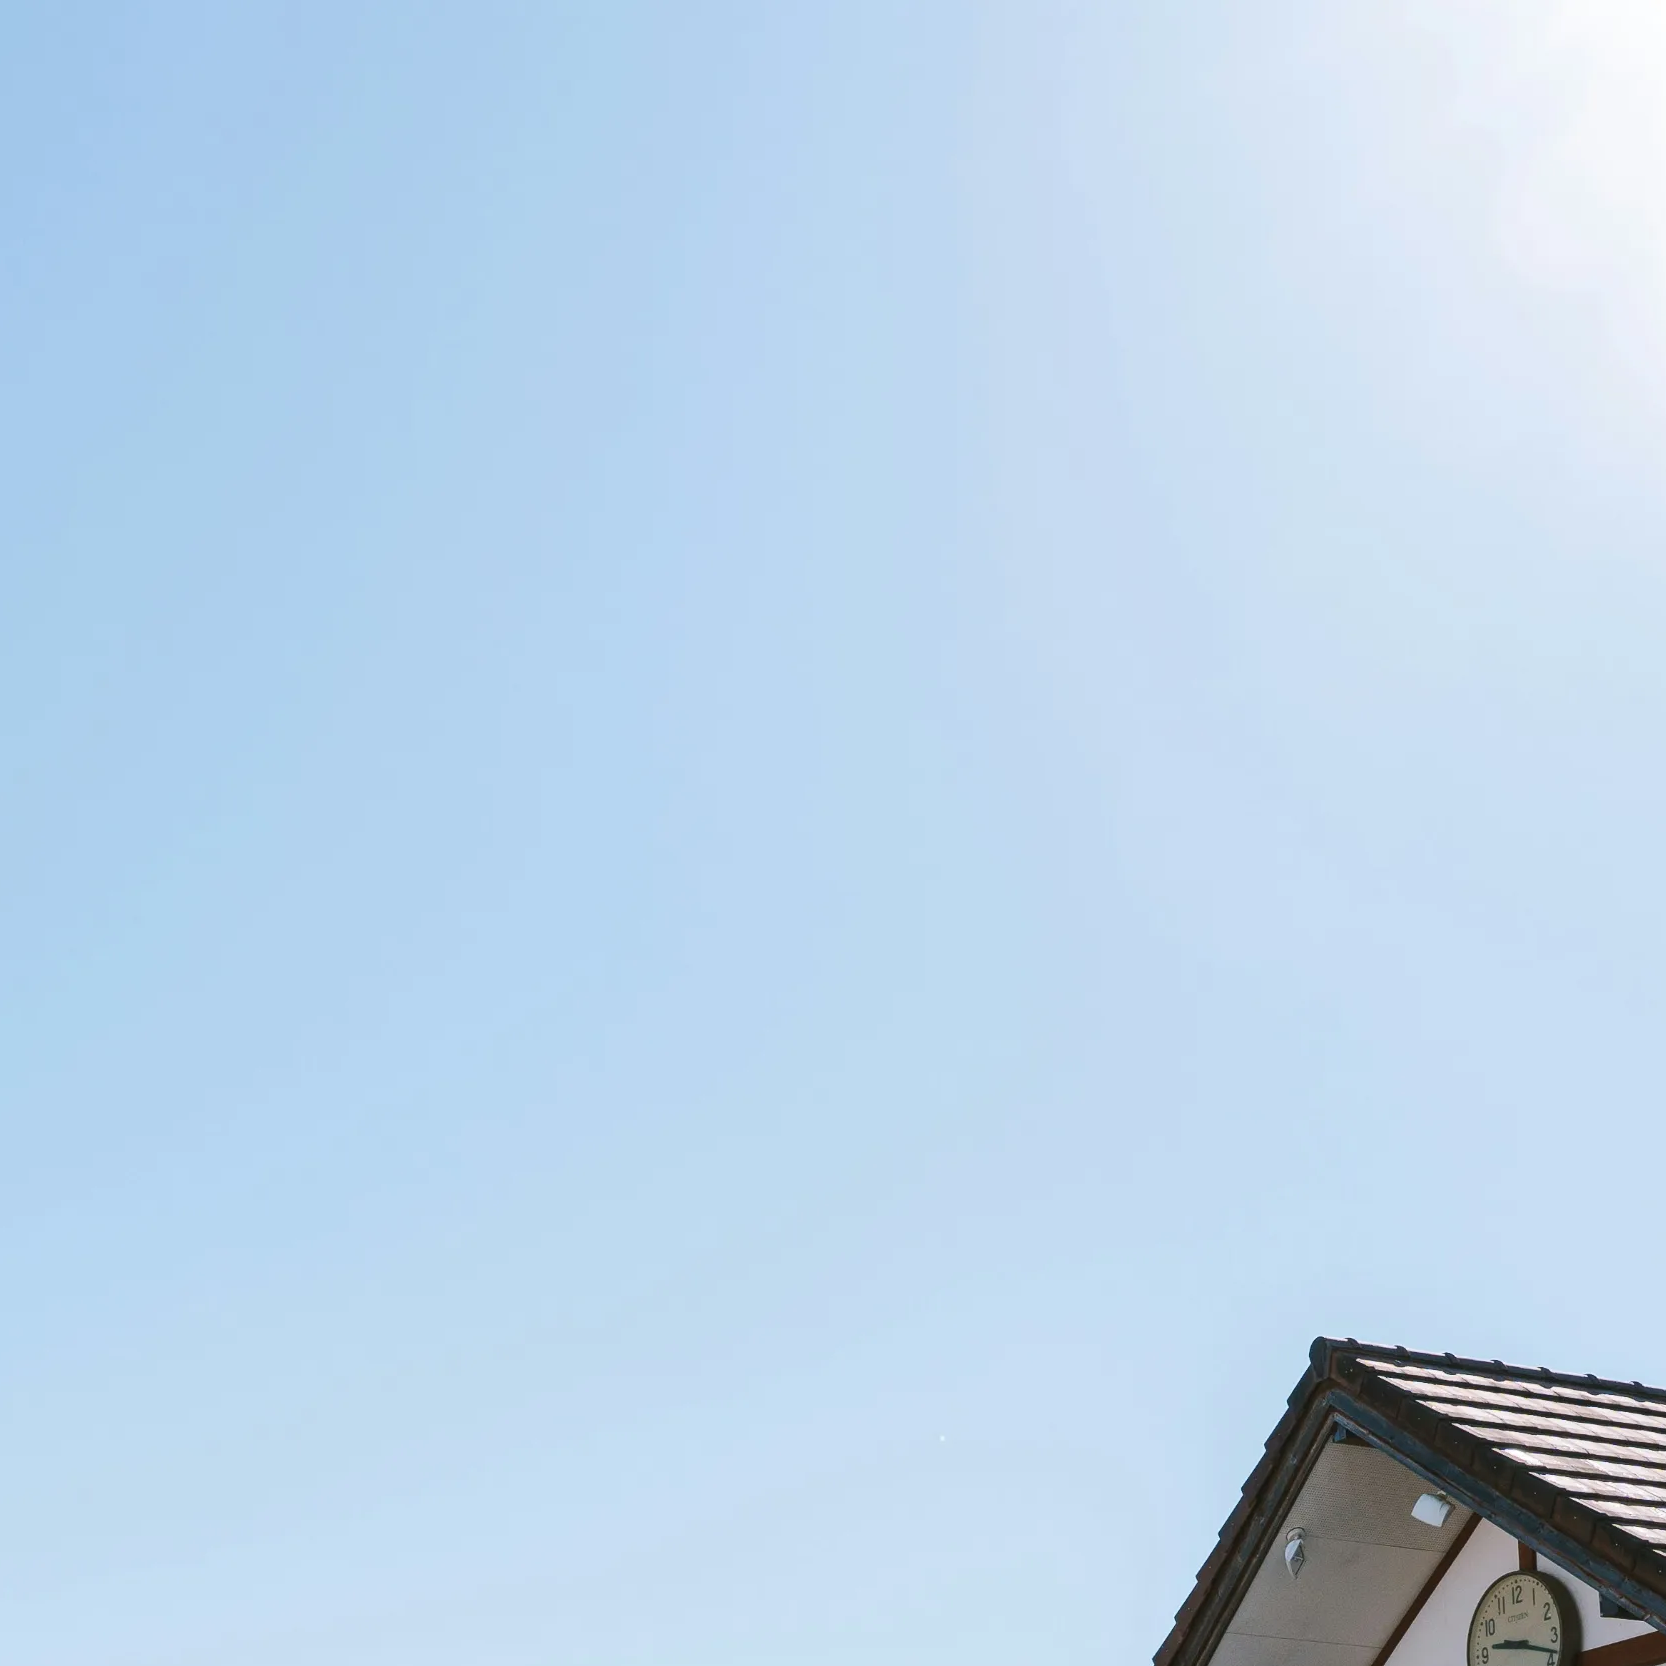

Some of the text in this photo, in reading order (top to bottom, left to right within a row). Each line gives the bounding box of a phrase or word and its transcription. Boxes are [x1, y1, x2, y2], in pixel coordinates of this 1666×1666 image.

[1511, 1585, 1523, 1605] 12
[1497, 1596, 1506, 1616] 11
[1543, 1602, 1551, 1621] 2
[1485, 1618, 1496, 1638] 10
[1550, 1626, 1559, 1644] 3
[1481, 1647, 1489, 1665] 9
